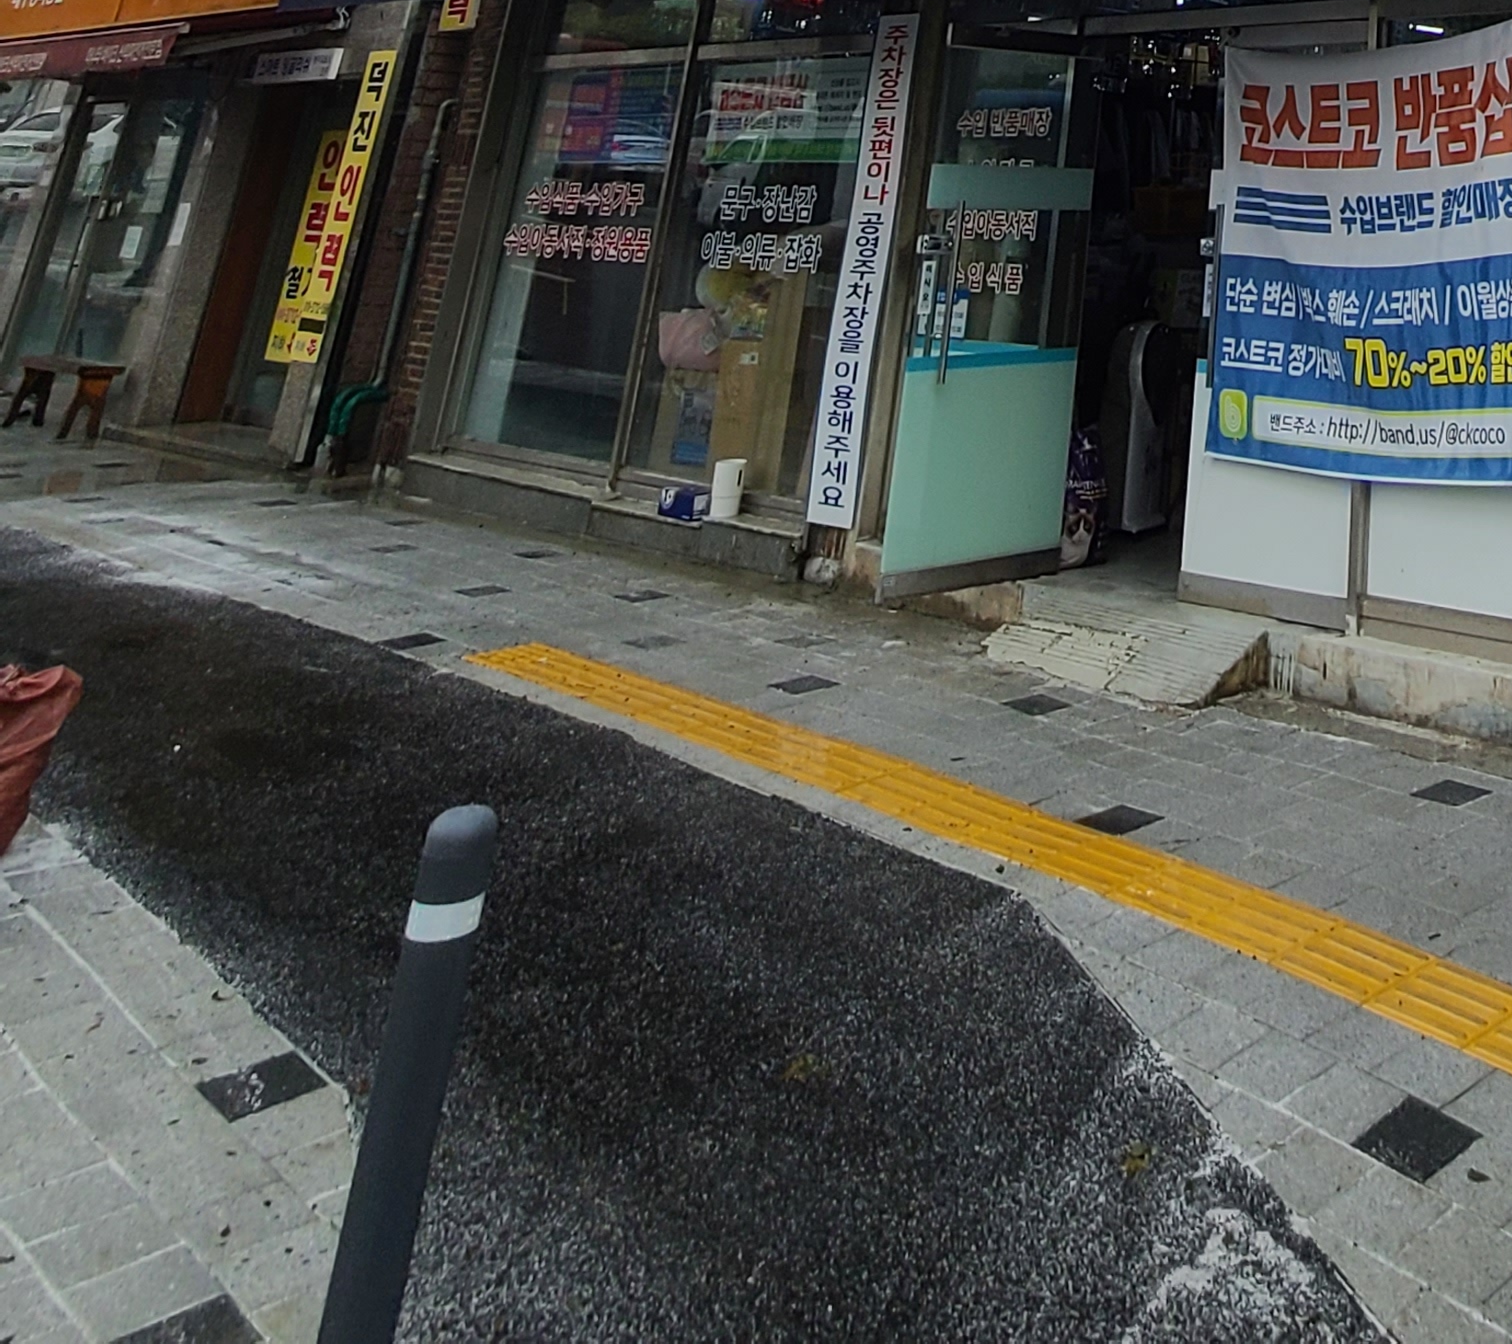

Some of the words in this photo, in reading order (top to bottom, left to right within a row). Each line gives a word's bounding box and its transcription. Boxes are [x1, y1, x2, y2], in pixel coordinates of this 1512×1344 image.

[873, 23, 909, 111] 주차장은
[862, 115, 898, 208] 뒷편이나
[1240, 81, 1381, 169] 코스트코
[1338, 192, 1434, 235] 수입브랜드
[836, 211, 885, 356] 공영주차장을
[1225, 277, 1258, 313] 단순
[1327, 290, 1361, 328] 훼손
[1371, 286, 1439, 326] 스크래치
[1221, 337, 1283, 374] 코스트코
[1344, 337, 1487, 388] 70%~20%
[817, 359, 860, 510] 이용해주세요
[1270, 413, 1317, 436] 밴드주소
[1326, 416, 1506, 447] http://band.us/@ckcoco
